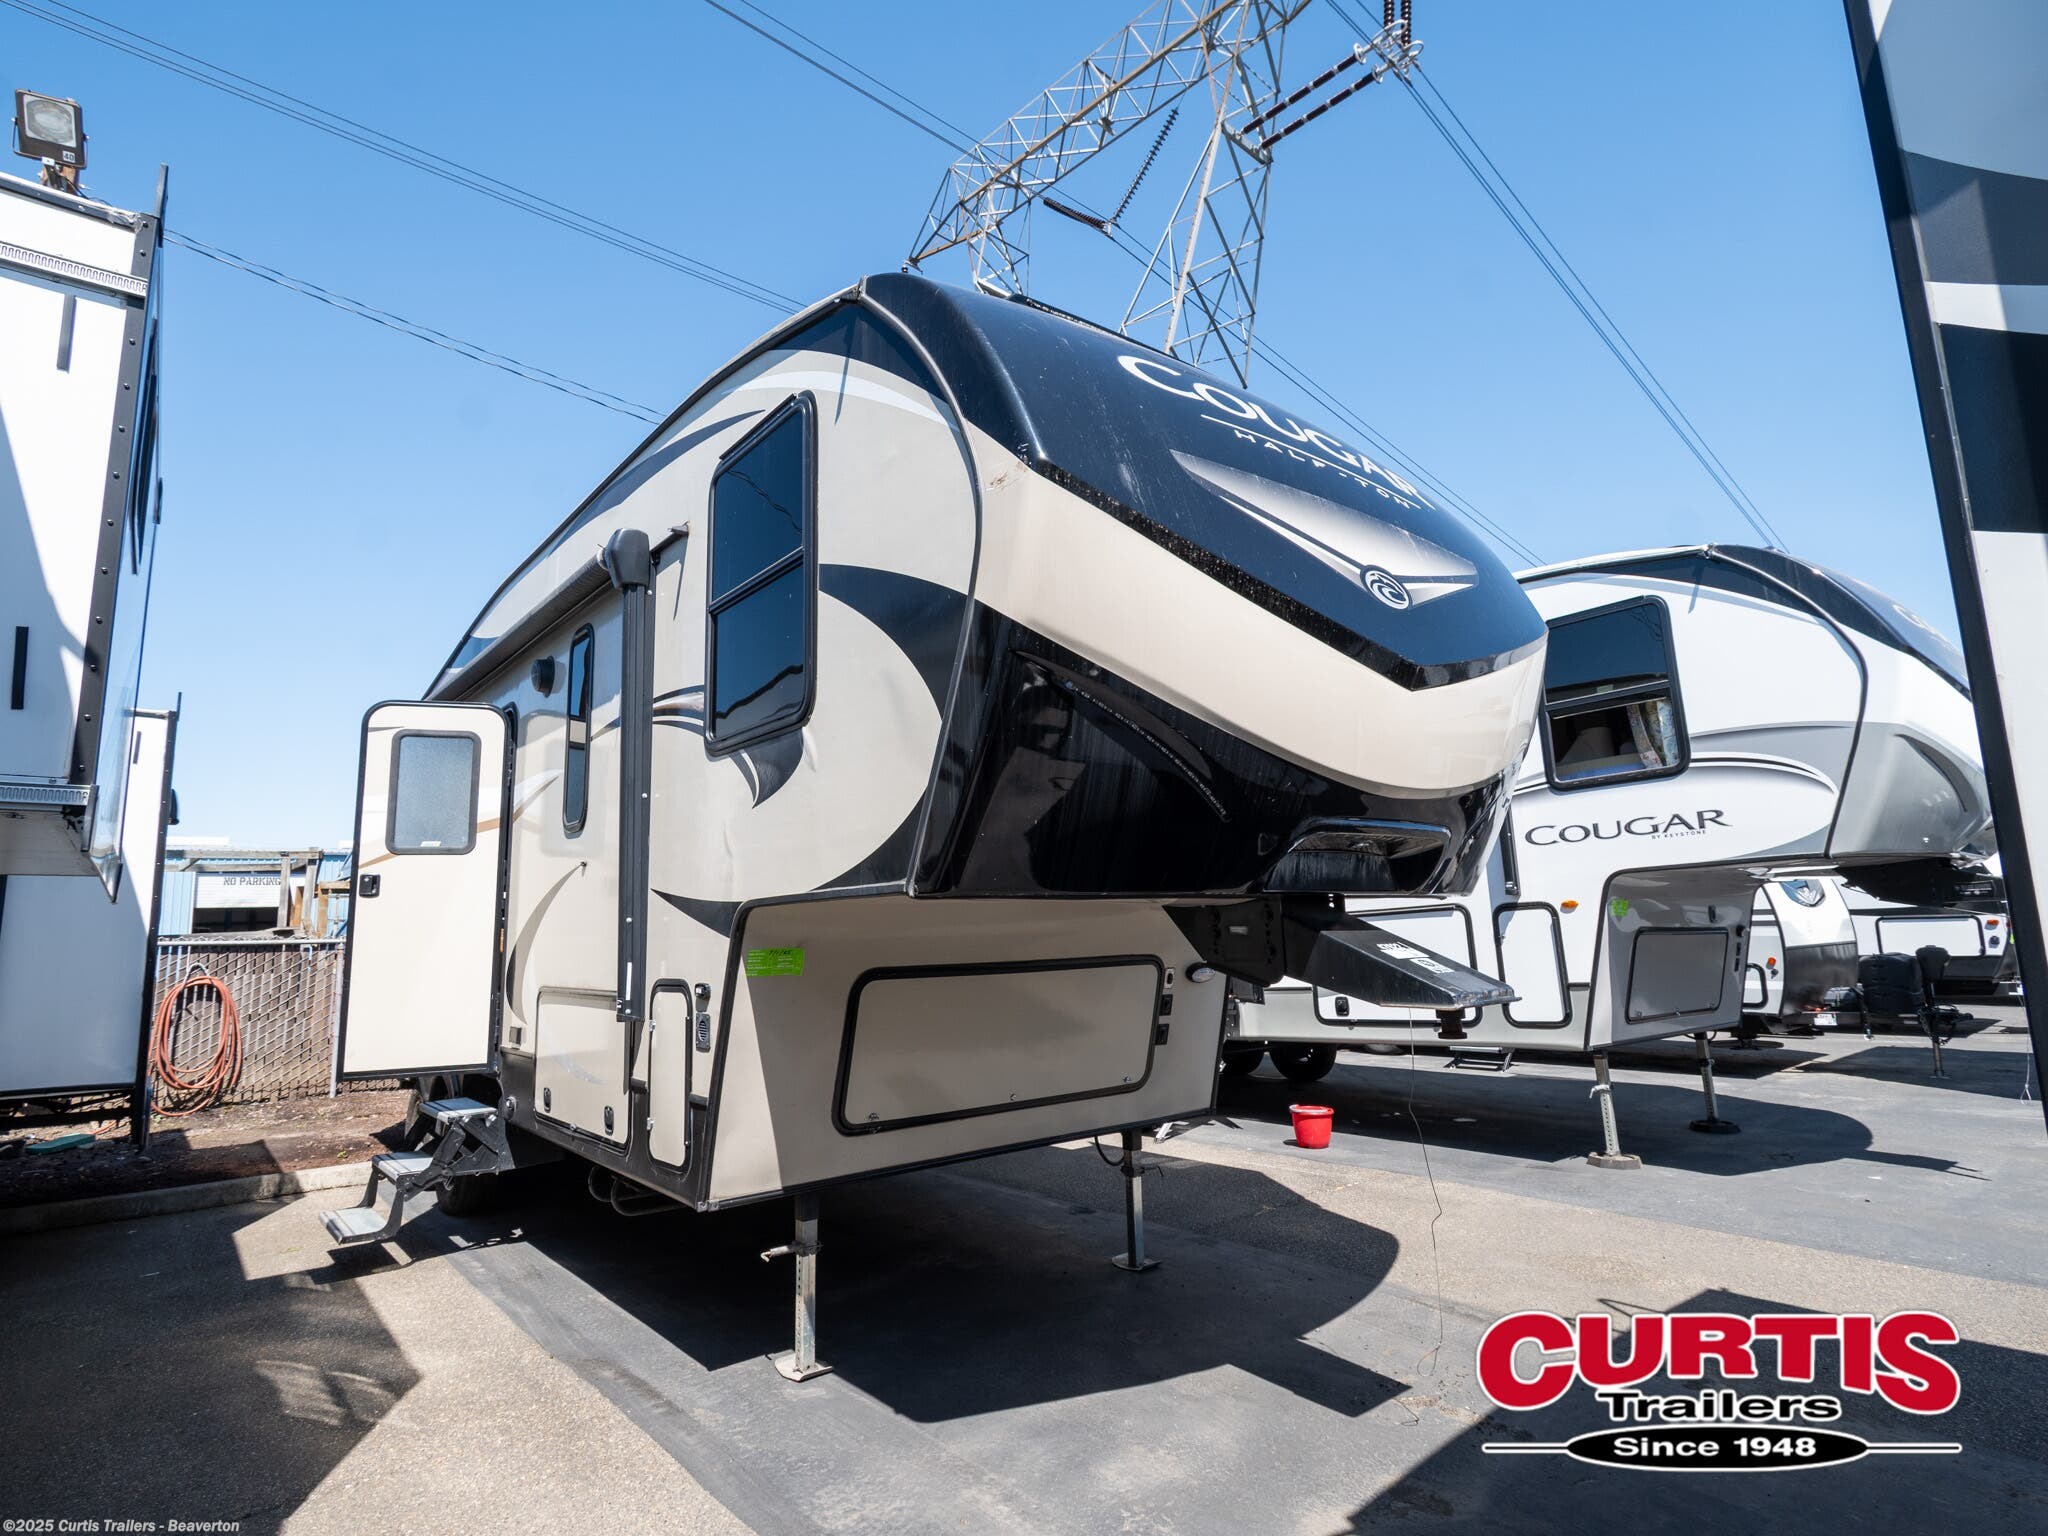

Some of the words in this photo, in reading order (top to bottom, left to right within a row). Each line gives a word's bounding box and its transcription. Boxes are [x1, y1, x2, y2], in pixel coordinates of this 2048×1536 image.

[1118, 355, 1436, 511] COUGAR
[1525, 809, 1733, 845] COUGAR
[1664, 829, 1706, 838] KEYSTONE
[223, 877, 237, 886] NO
[239, 877, 281, 886] PARKING
